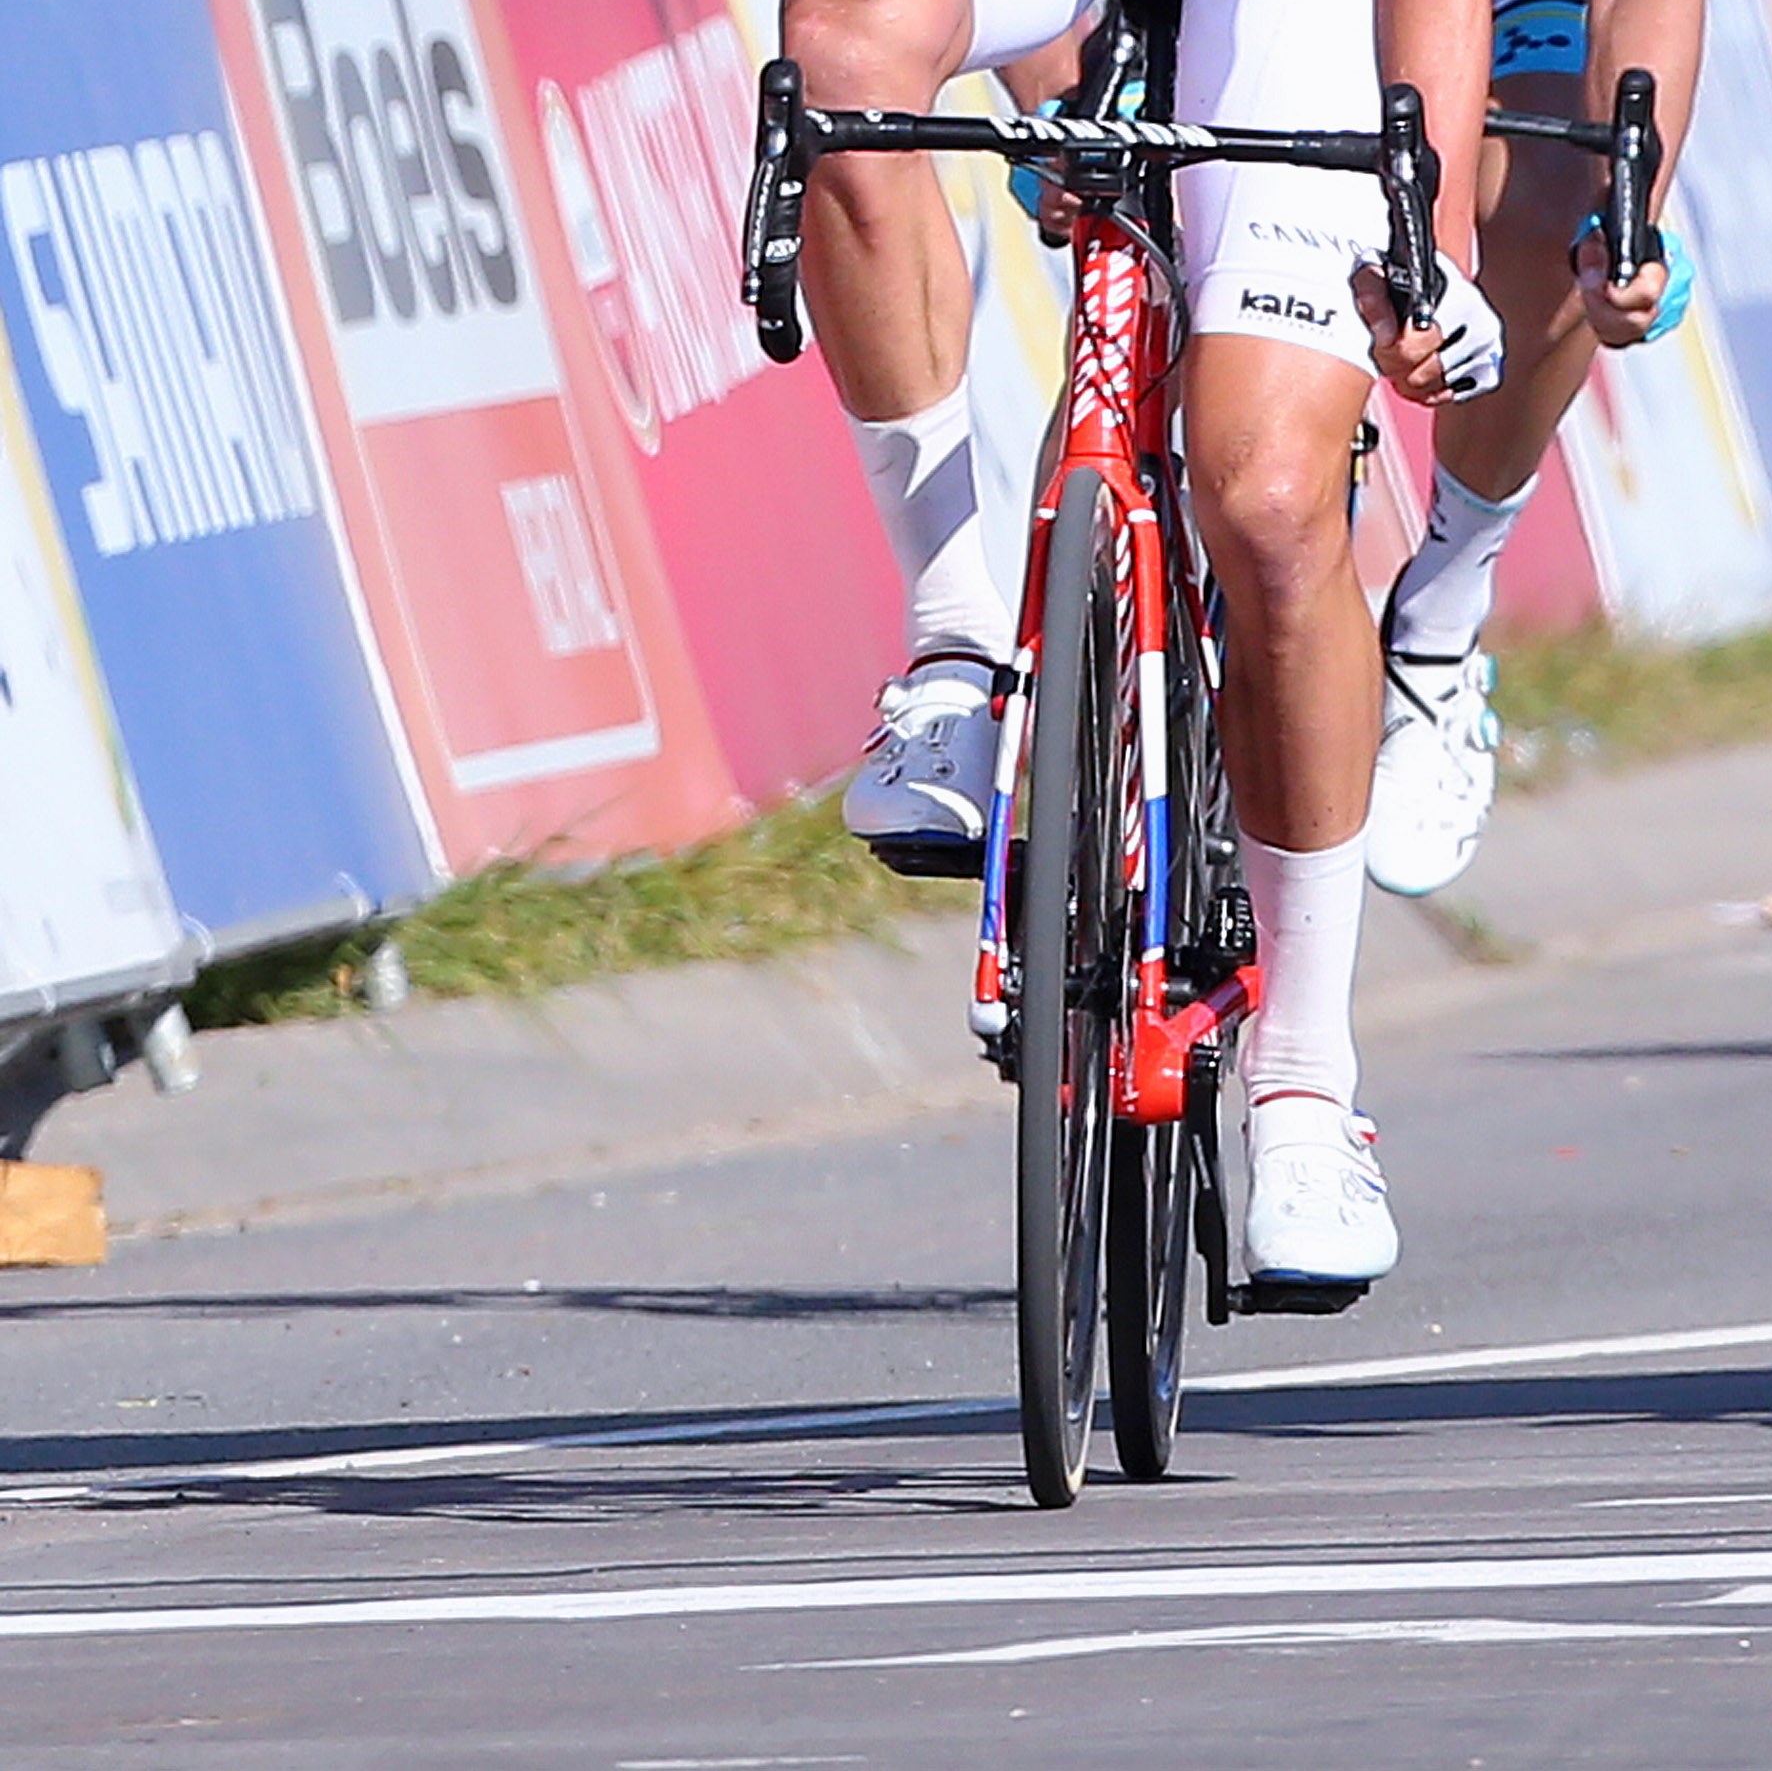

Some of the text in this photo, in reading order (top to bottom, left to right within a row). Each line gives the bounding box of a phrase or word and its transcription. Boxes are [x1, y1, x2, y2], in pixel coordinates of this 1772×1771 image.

[1249, 222, 1364, 259] CANYO
[1241, 289, 1337, 326] kalas
[0, 128, 315, 557] SHIMANO
